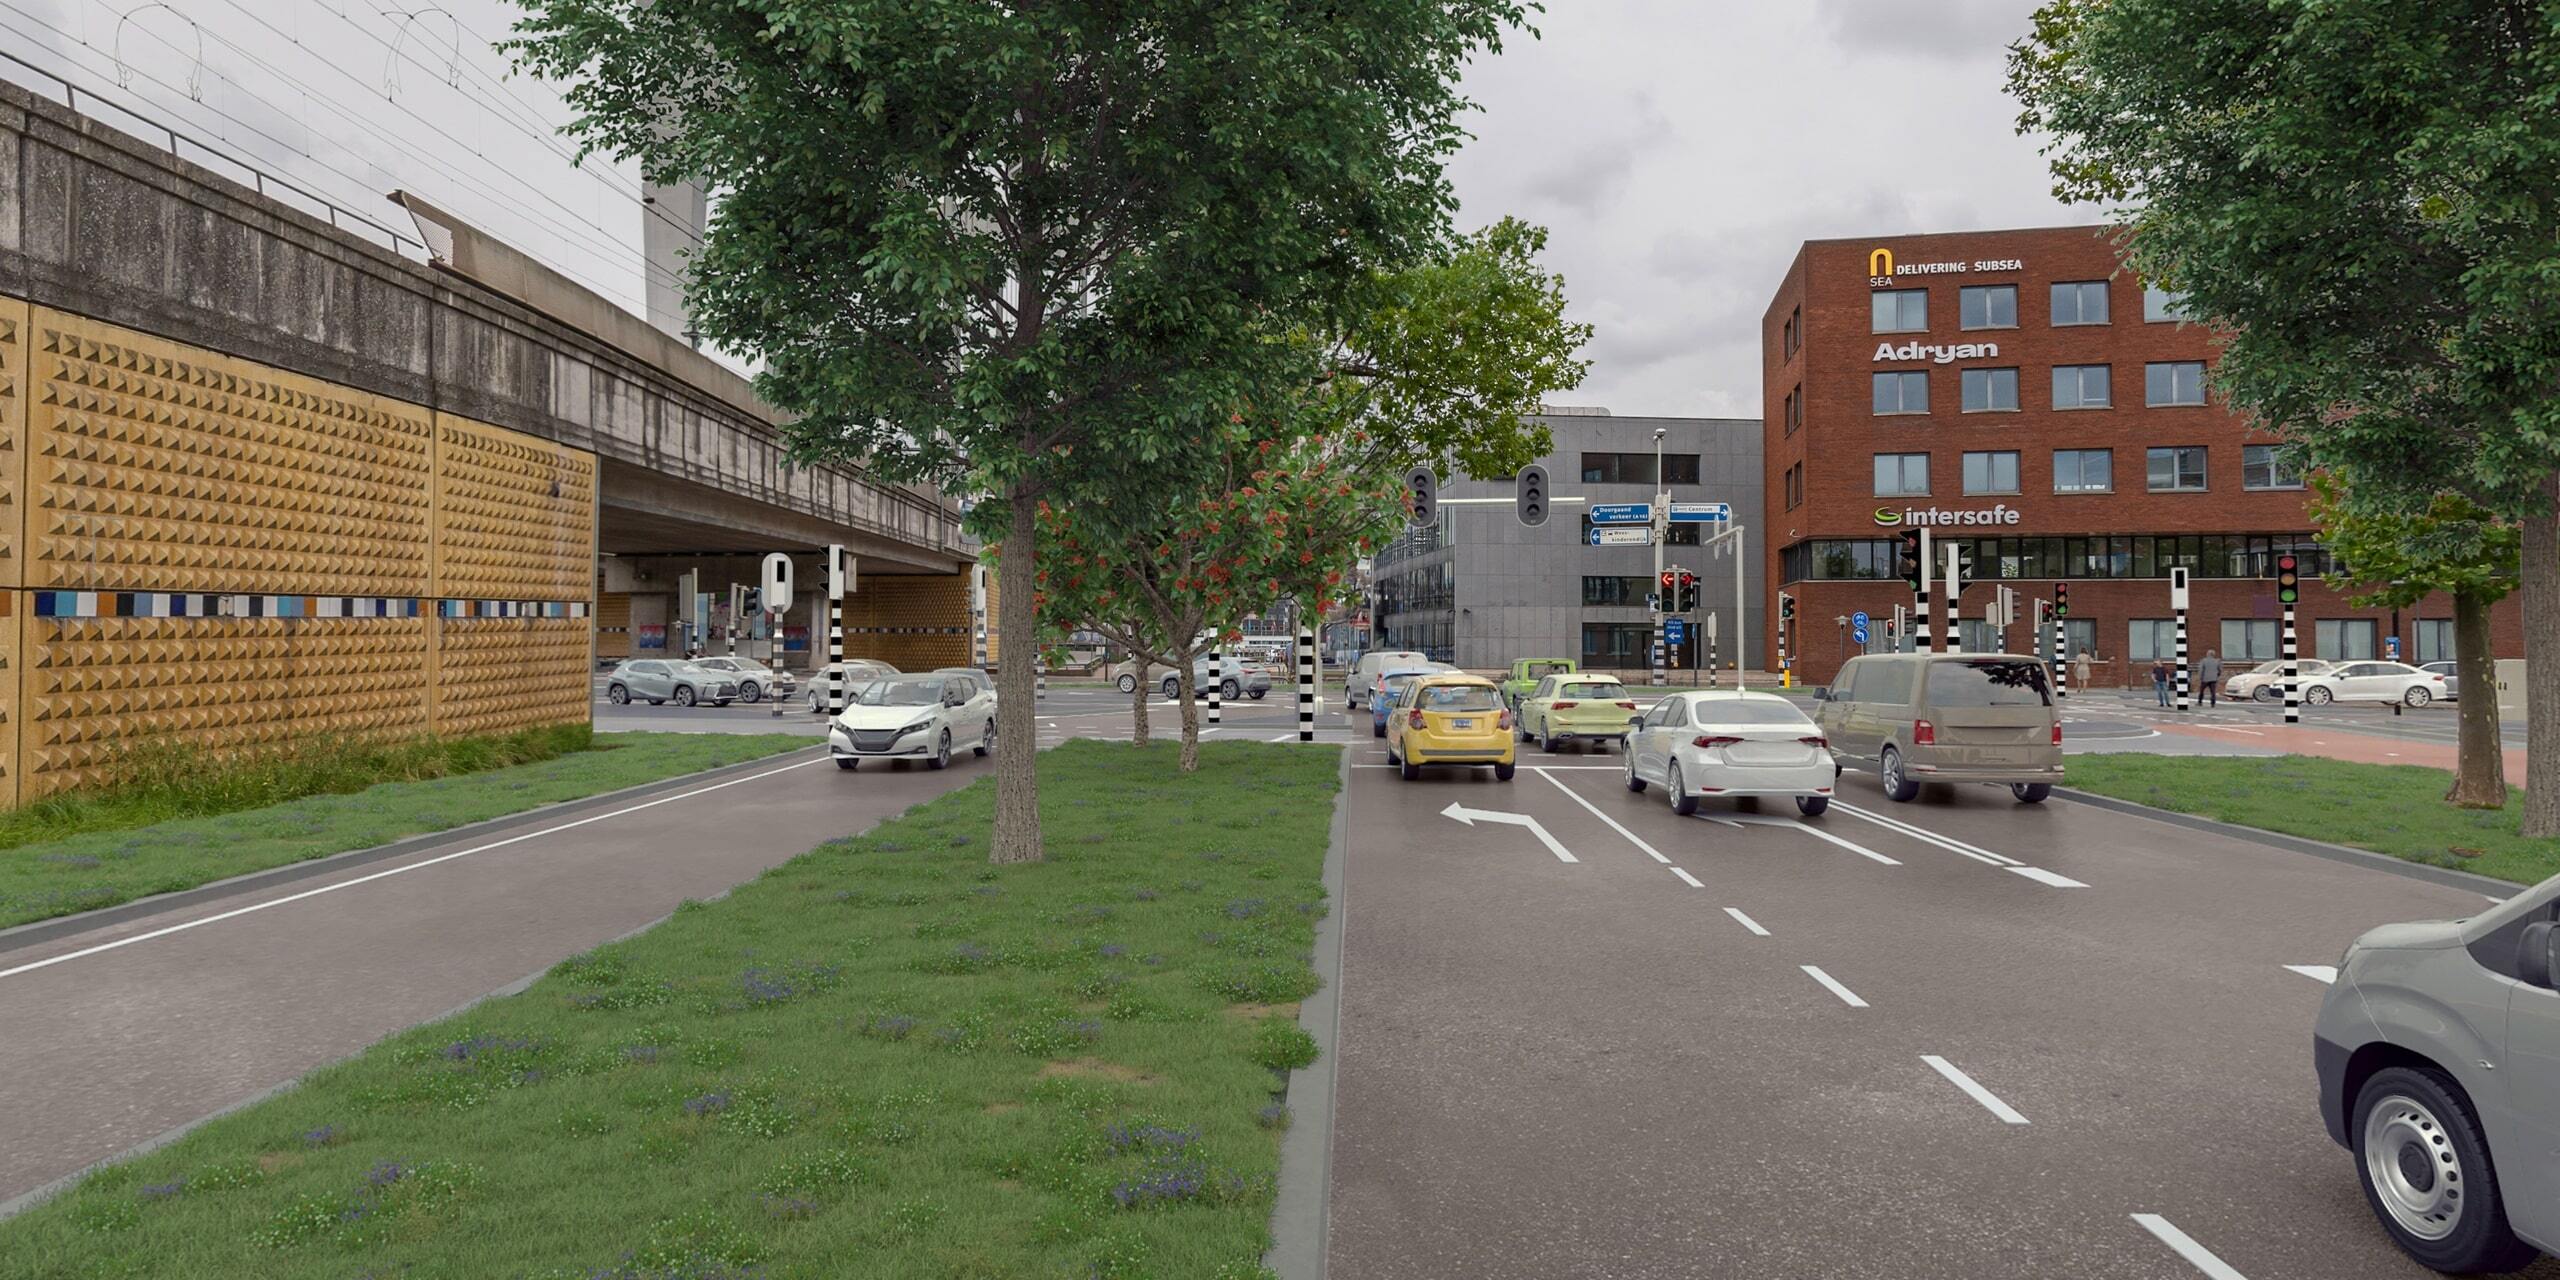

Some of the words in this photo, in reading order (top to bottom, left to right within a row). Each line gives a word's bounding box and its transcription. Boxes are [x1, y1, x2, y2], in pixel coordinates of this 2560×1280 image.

[1896, 261, 1967, 276] DELIVERING
[1973, 259, 2023, 272] SUBSEA
[1870, 277, 1893, 287] SEA
[1872, 341, 1999, 364] Adryan
[1905, 504, 2020, 526] intersafe
